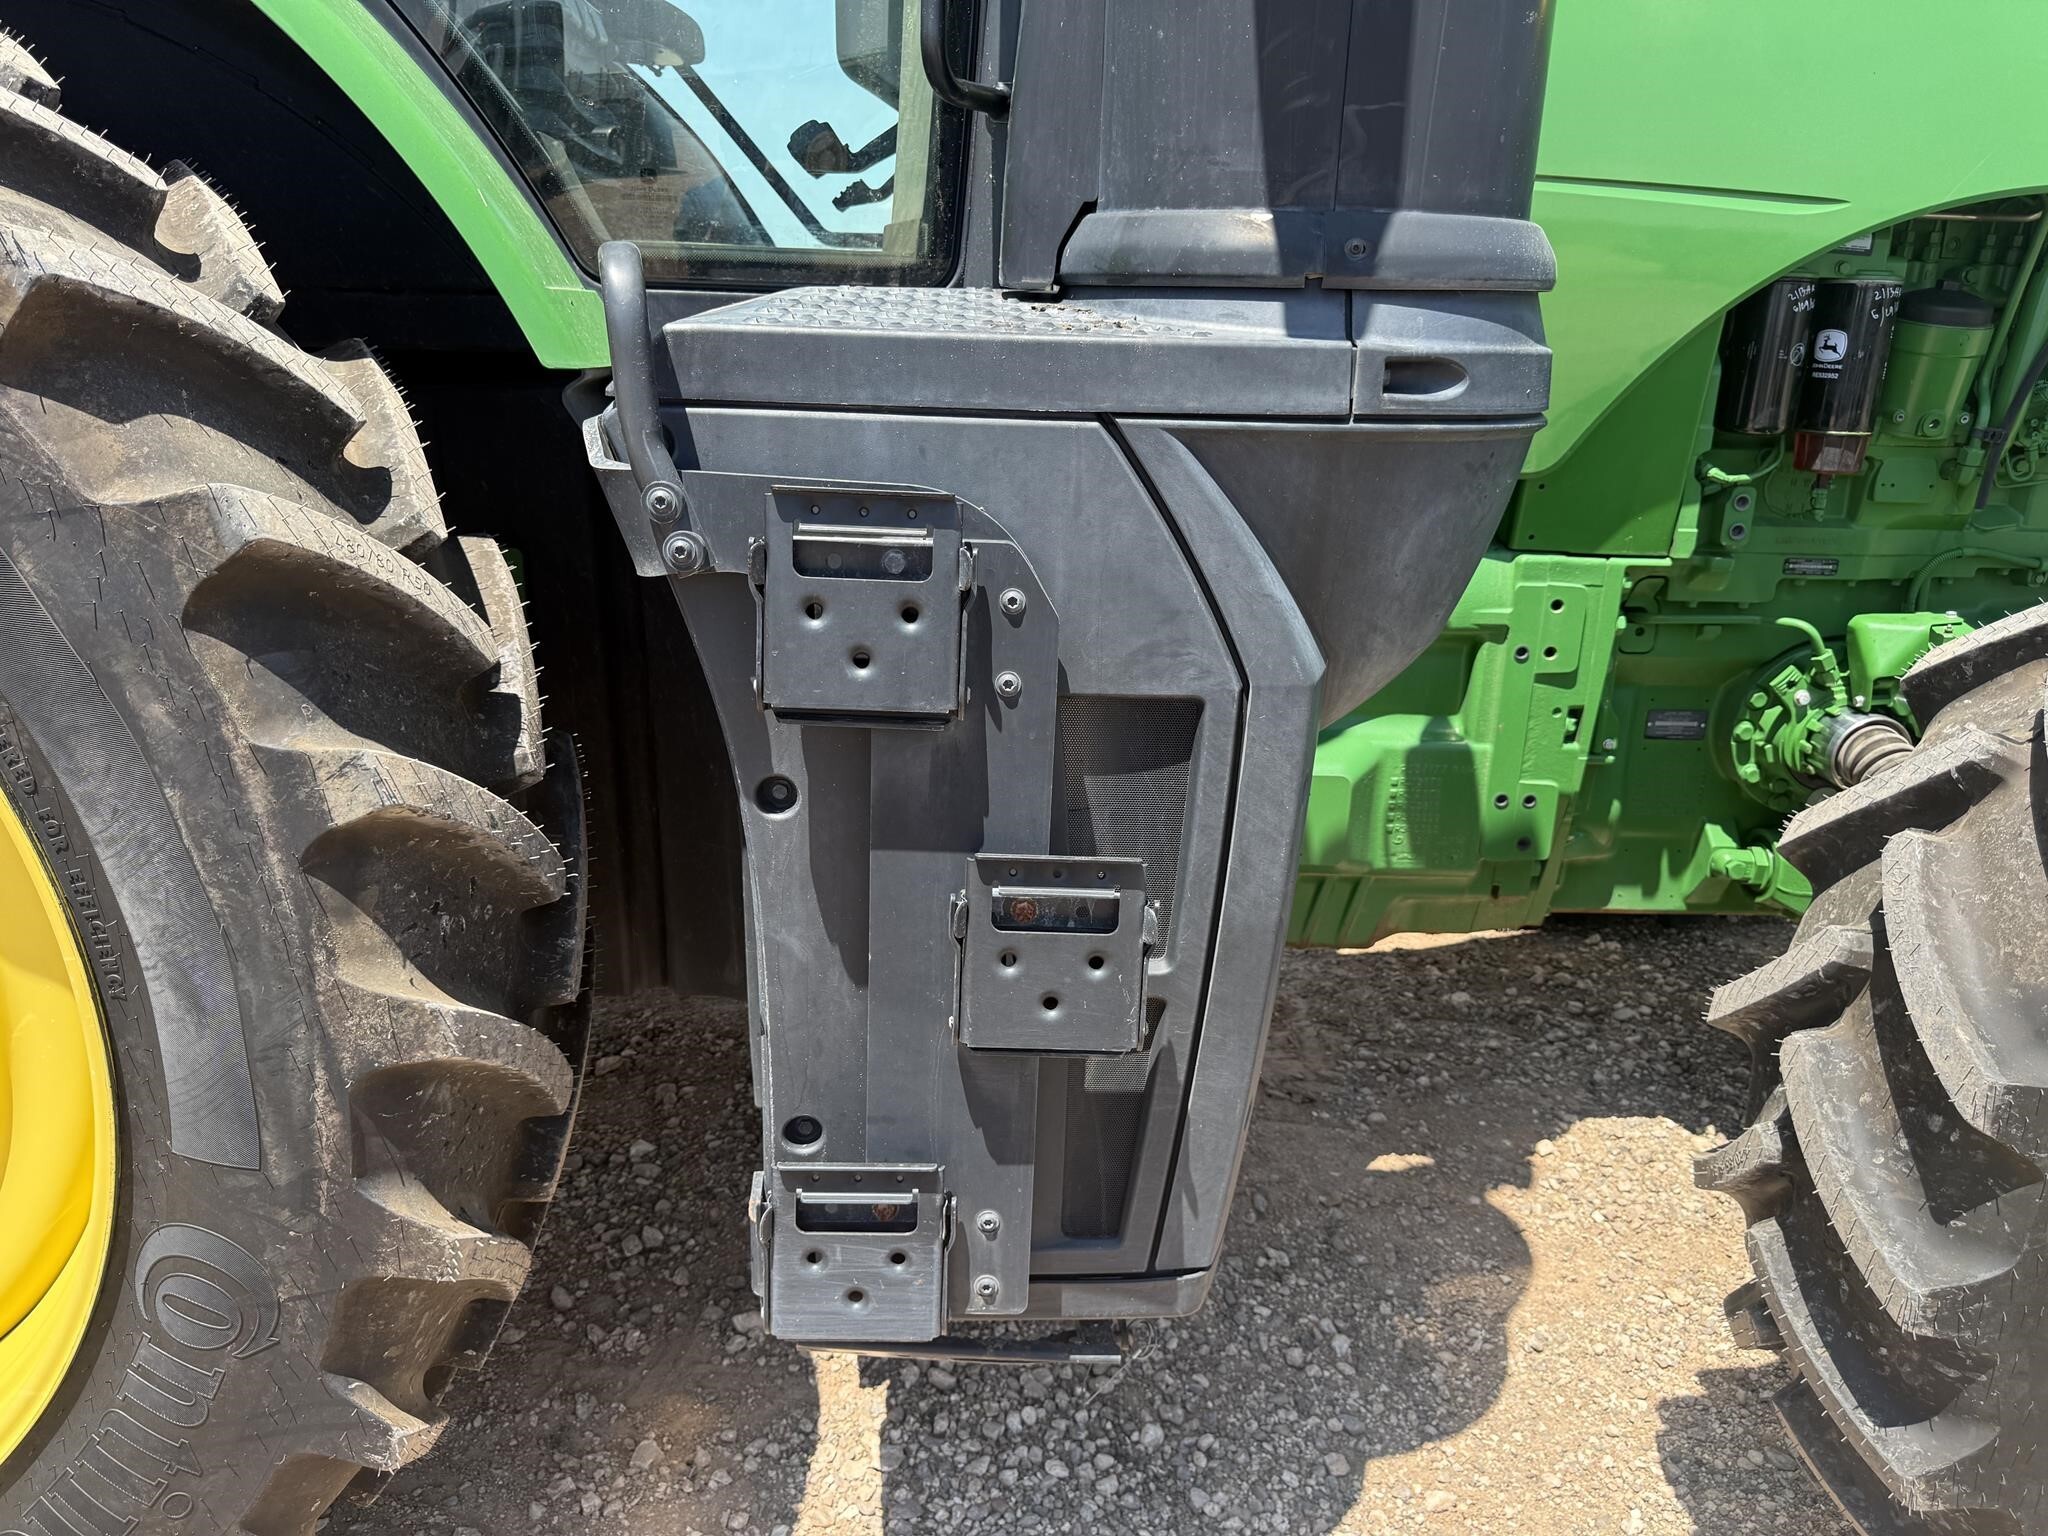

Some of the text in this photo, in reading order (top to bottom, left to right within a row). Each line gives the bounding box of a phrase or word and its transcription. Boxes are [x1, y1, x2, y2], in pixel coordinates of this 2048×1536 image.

[34, 806, 69, 856] FOR
[65, 868, 127, 1003] EFFICIENCY
[0, 1223, 281, 1536] Contin
